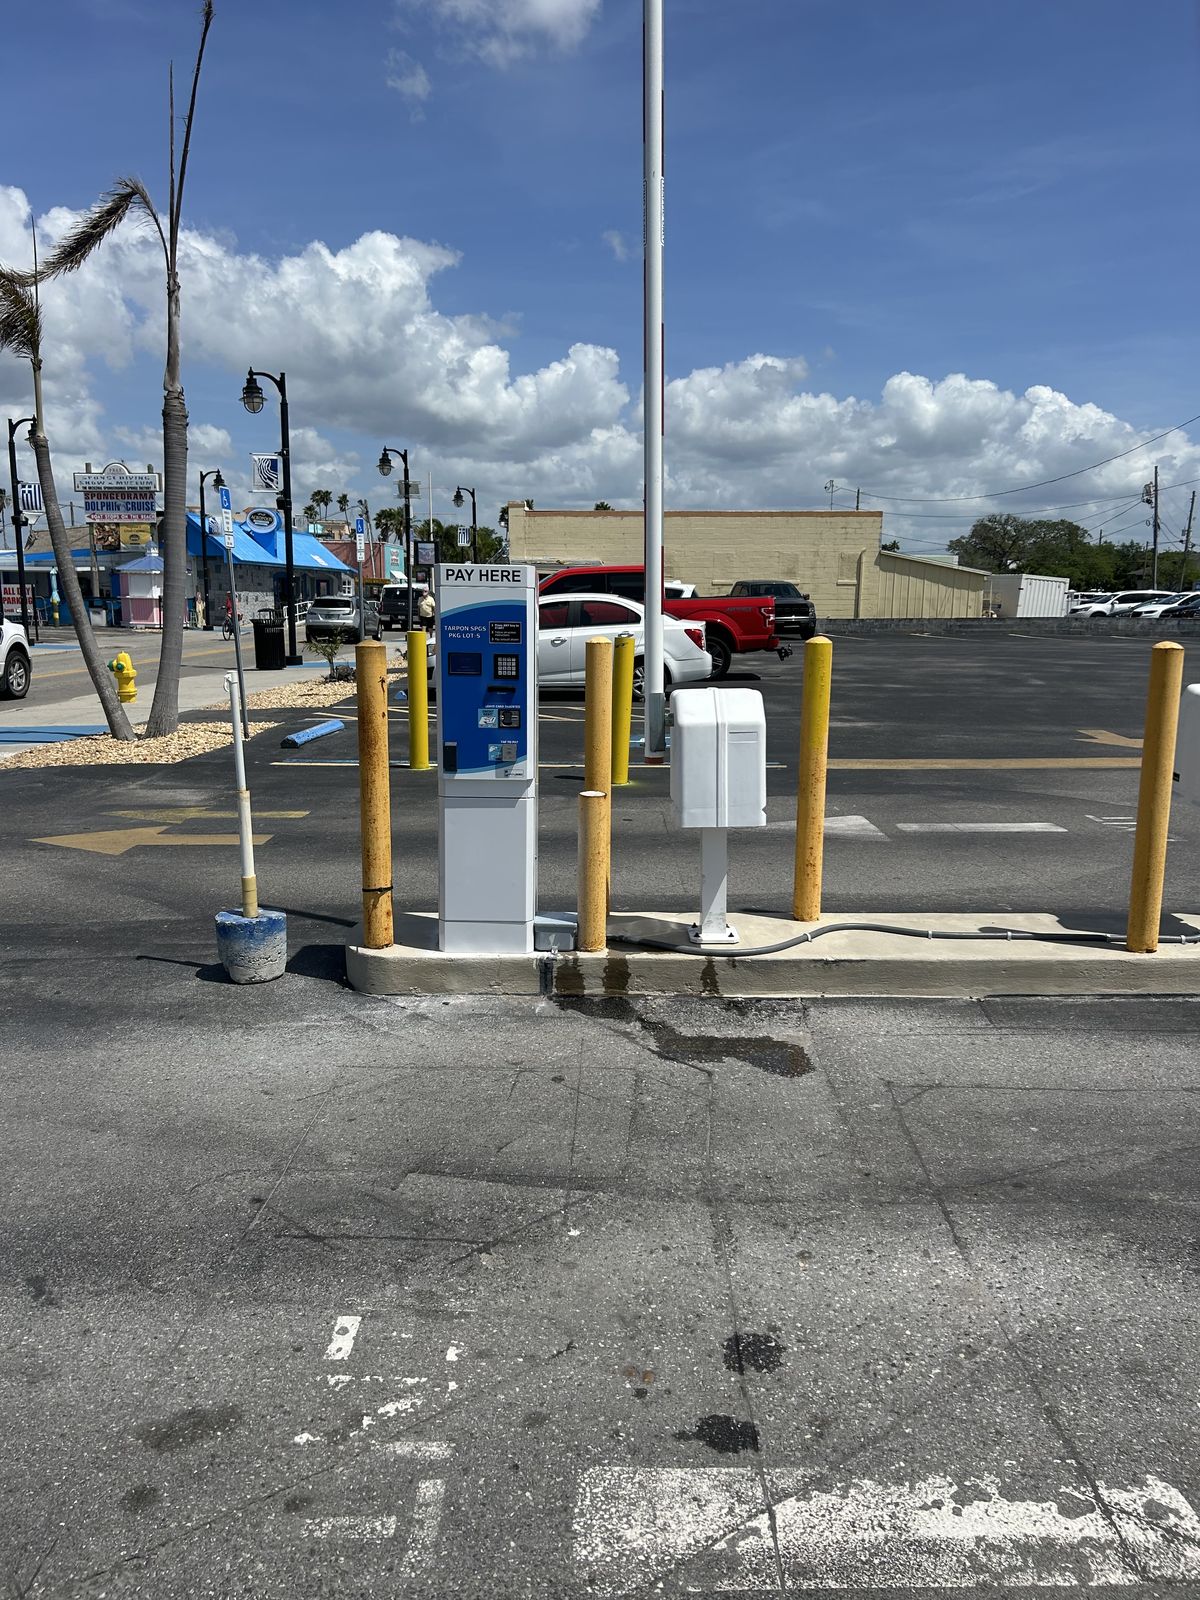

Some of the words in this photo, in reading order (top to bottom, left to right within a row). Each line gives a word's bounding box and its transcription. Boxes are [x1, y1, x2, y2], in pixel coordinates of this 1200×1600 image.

[84, 492, 154, 500] SPONGEORAMA
[85, 501, 120, 512] DOLPHIN
[125, 501, 156, 512] CRUISE
[445, 568, 475, 582] PAY
[479, 569, 522, 582] HERE
[3, 587, 16, 596] ALL
